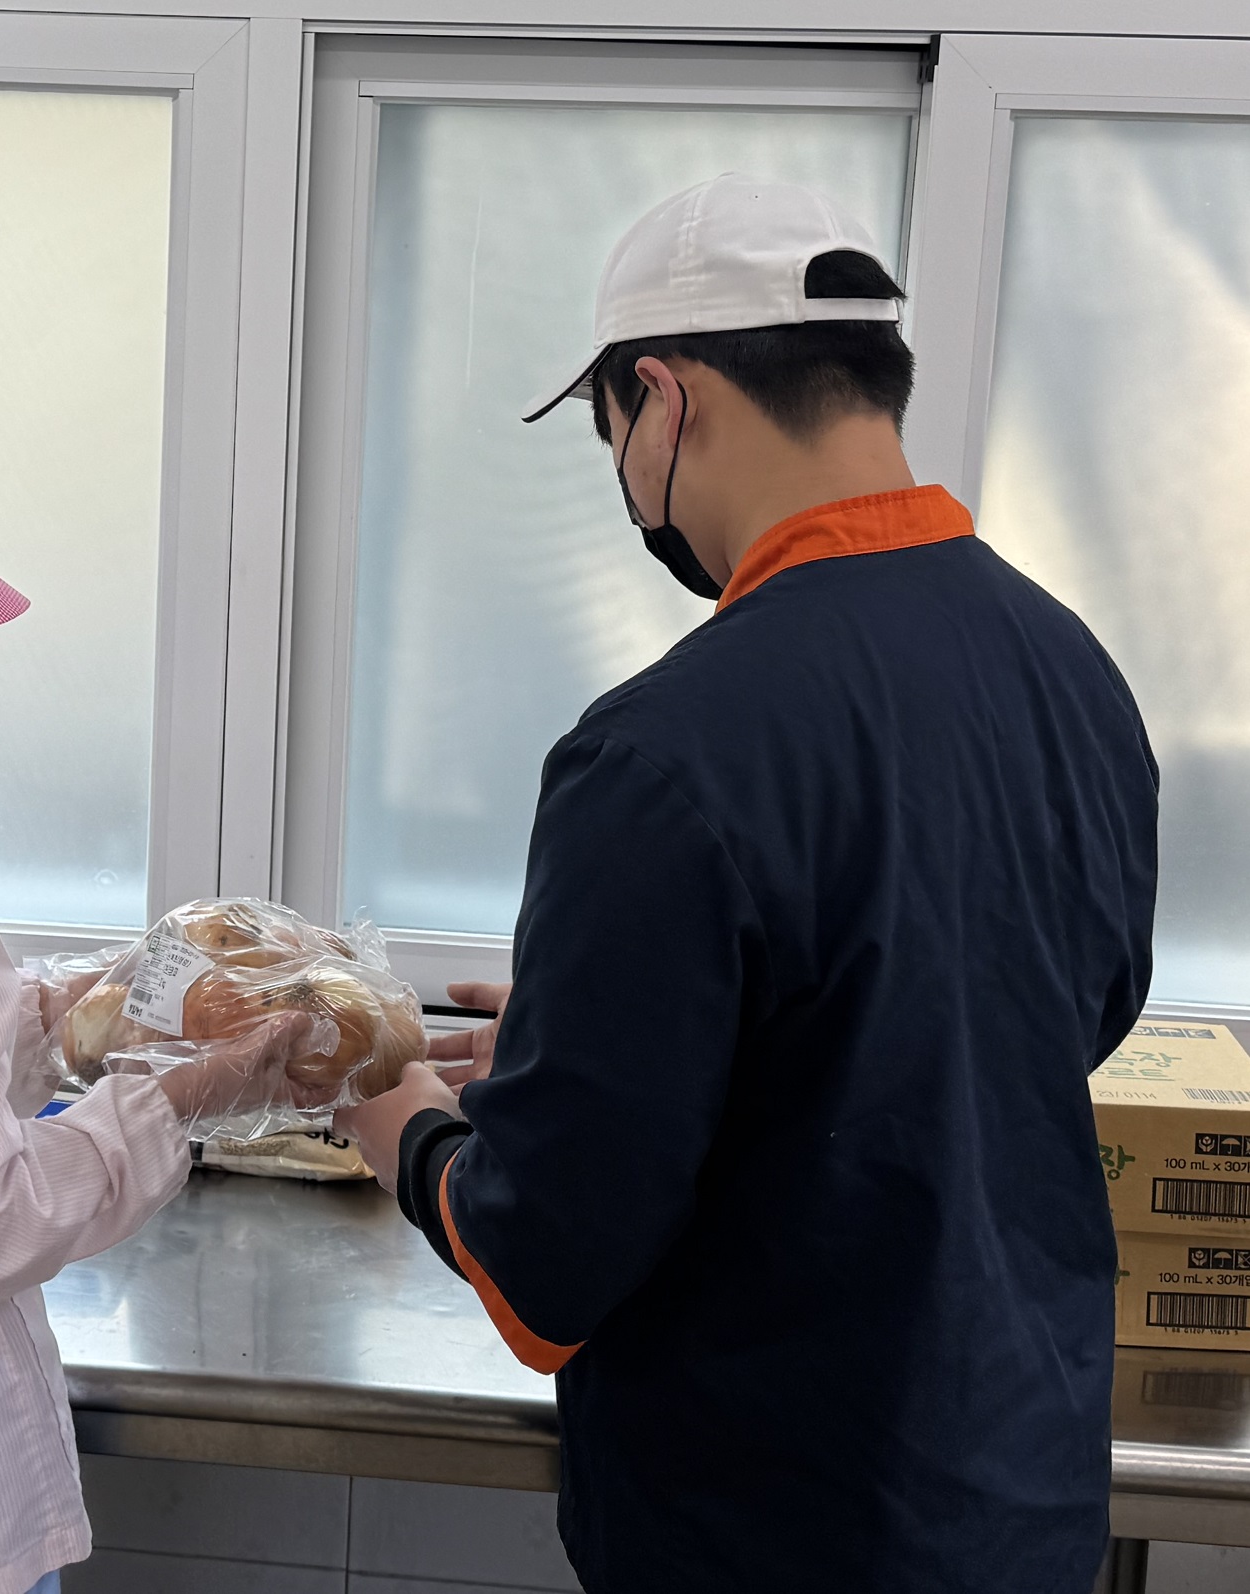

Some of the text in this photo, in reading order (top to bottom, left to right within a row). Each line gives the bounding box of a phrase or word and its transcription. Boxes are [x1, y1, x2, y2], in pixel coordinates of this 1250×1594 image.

[1163, 1157, 1187, 1169] 100
[1190, 1160, 1210, 1171] mL
[1213, 1161, 1222, 1172] x
[1158, 1271, 1181, 1284] 100
[1183, 1273, 1203, 1285] mL
[1205, 1275, 1215, 1285] x
